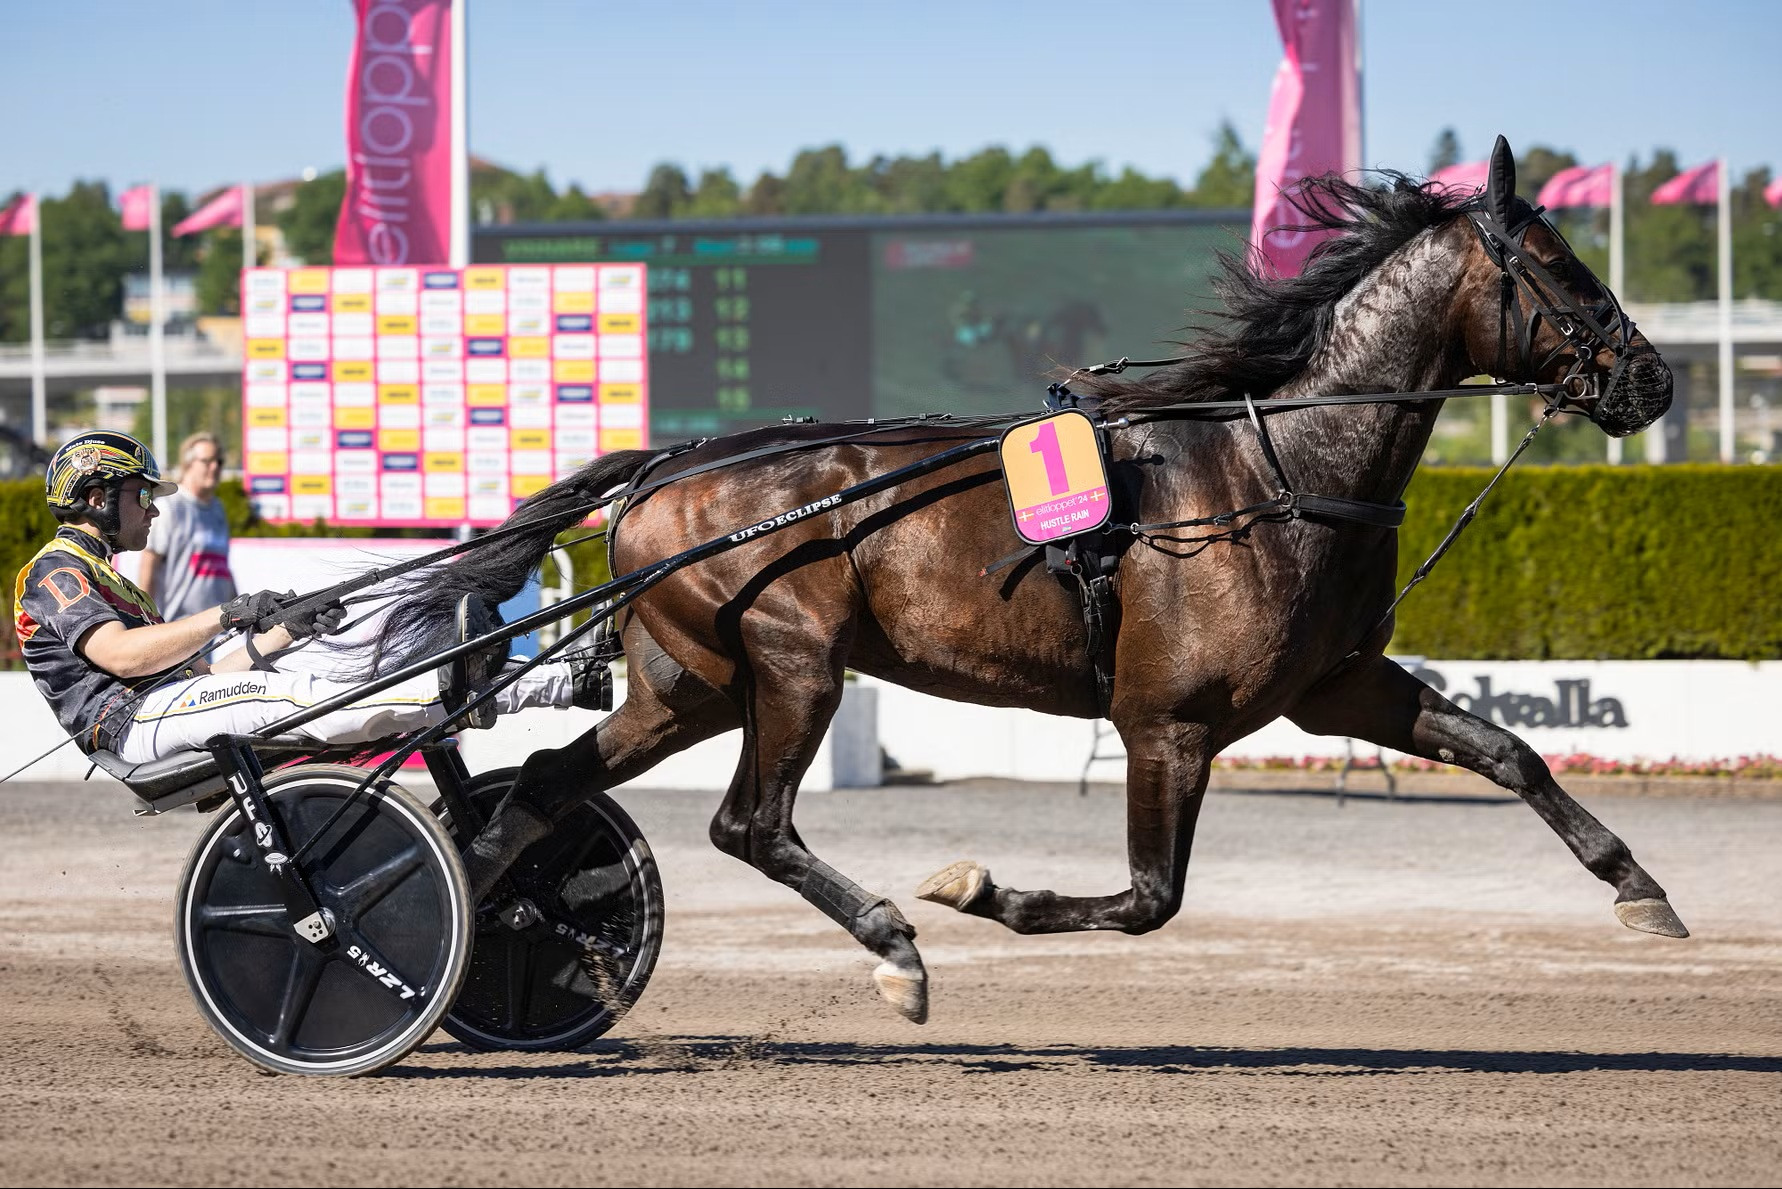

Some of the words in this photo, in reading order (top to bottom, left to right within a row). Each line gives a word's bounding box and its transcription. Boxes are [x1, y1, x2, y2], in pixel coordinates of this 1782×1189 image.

[1029, 422, 1070, 497] 1
[1040, 514, 1070, 530] HUSTLE
[1071, 509, 1089, 521] RAIN
[37, 567, 90, 613] D
[199, 681, 267, 704] Ramudden
